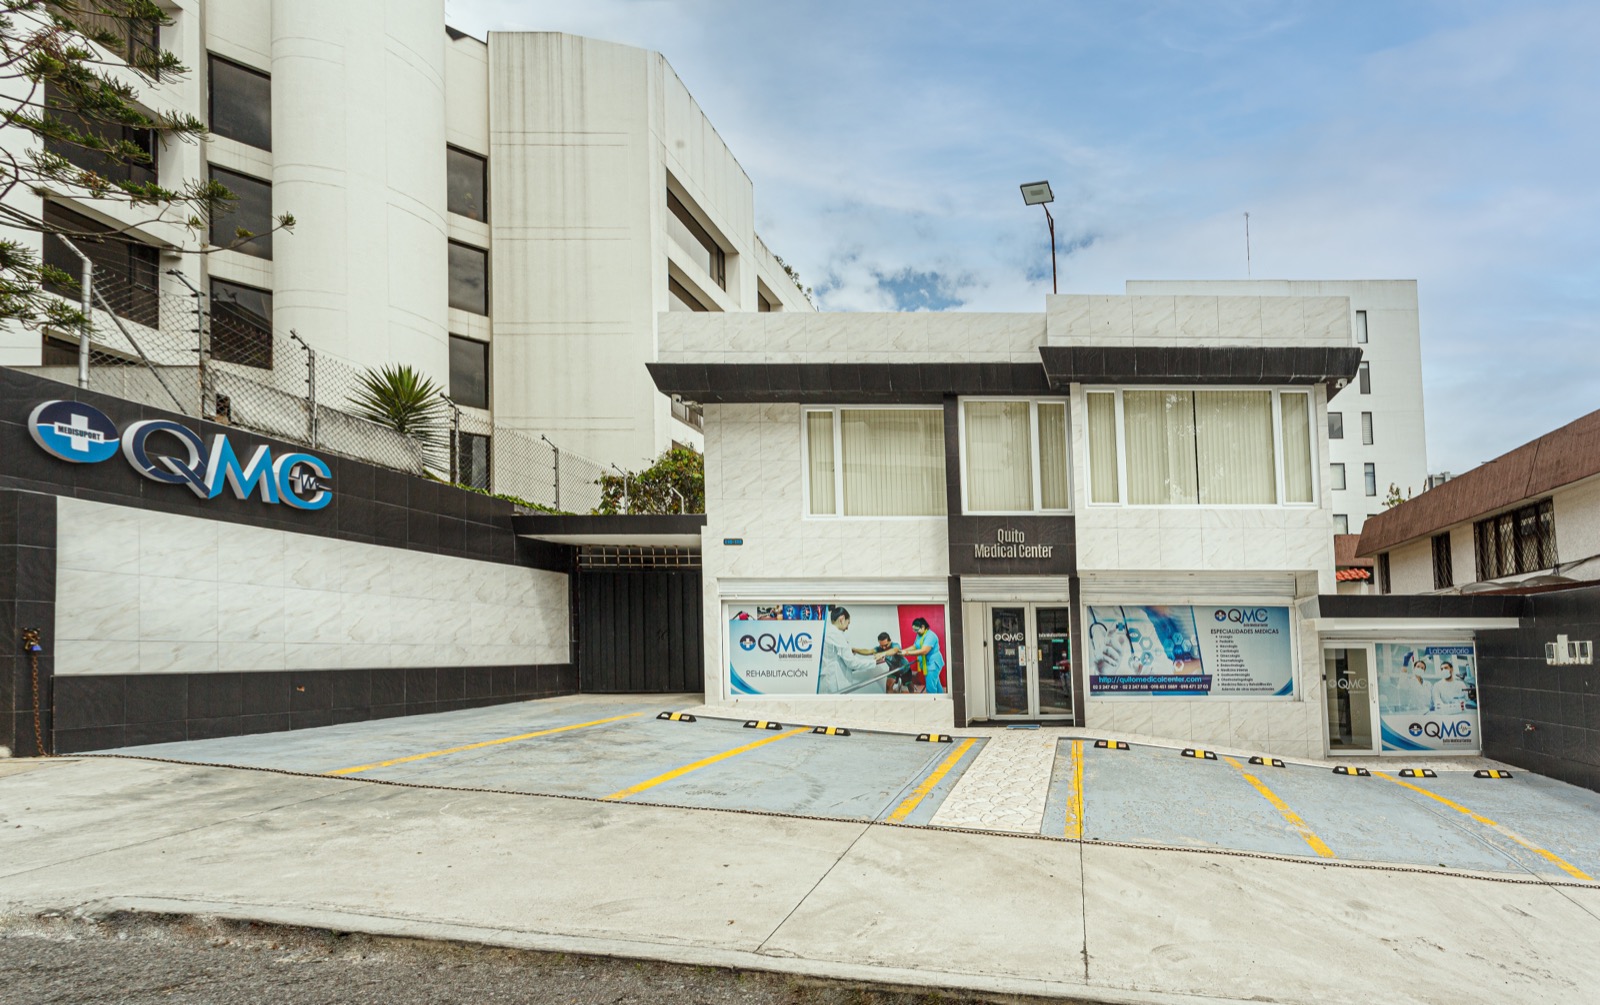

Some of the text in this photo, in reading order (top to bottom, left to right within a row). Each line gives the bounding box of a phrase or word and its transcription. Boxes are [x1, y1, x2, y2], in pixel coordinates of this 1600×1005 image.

[57, 425, 101, 440] MEDISUPORT
[123, 419, 332, 510] QMC
[997, 528, 1025, 544] Quito
[974, 543, 1053, 558] Medical Center
[1228, 608, 1268, 624] QMC
[757, 632, 813, 654] QMC
[1002, 632, 1024, 642] QMC
[1429, 647, 1469, 655] Laboratorio
[745, 669, 808, 677] REHABILITACIÓN
[1098, 676, 1202, 684] http://quitomedicalcenter.com
[1338, 678, 1367, 690] QMC
[1424, 720, 1471, 740] QMC
